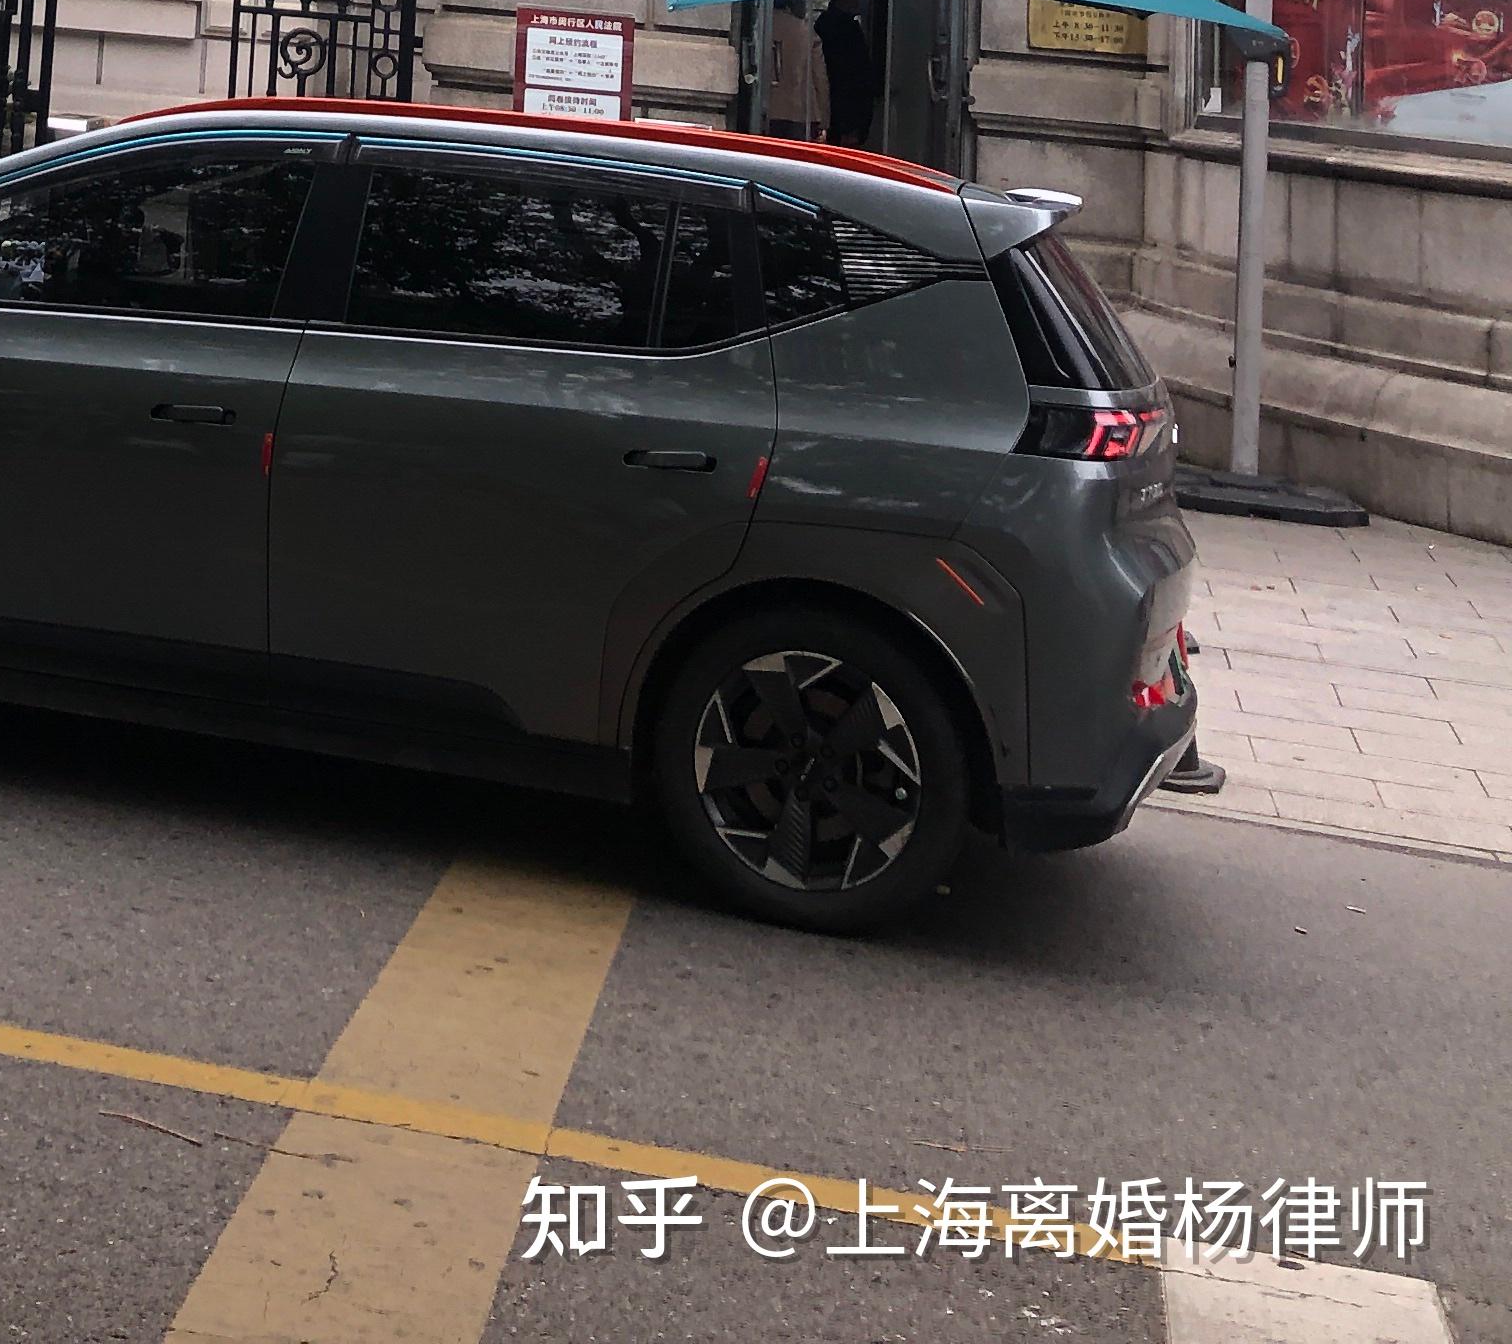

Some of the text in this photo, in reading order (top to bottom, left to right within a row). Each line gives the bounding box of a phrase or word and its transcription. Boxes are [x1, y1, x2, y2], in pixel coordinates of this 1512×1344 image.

[530, 14, 623, 31] 上海市闵行区人民法院
